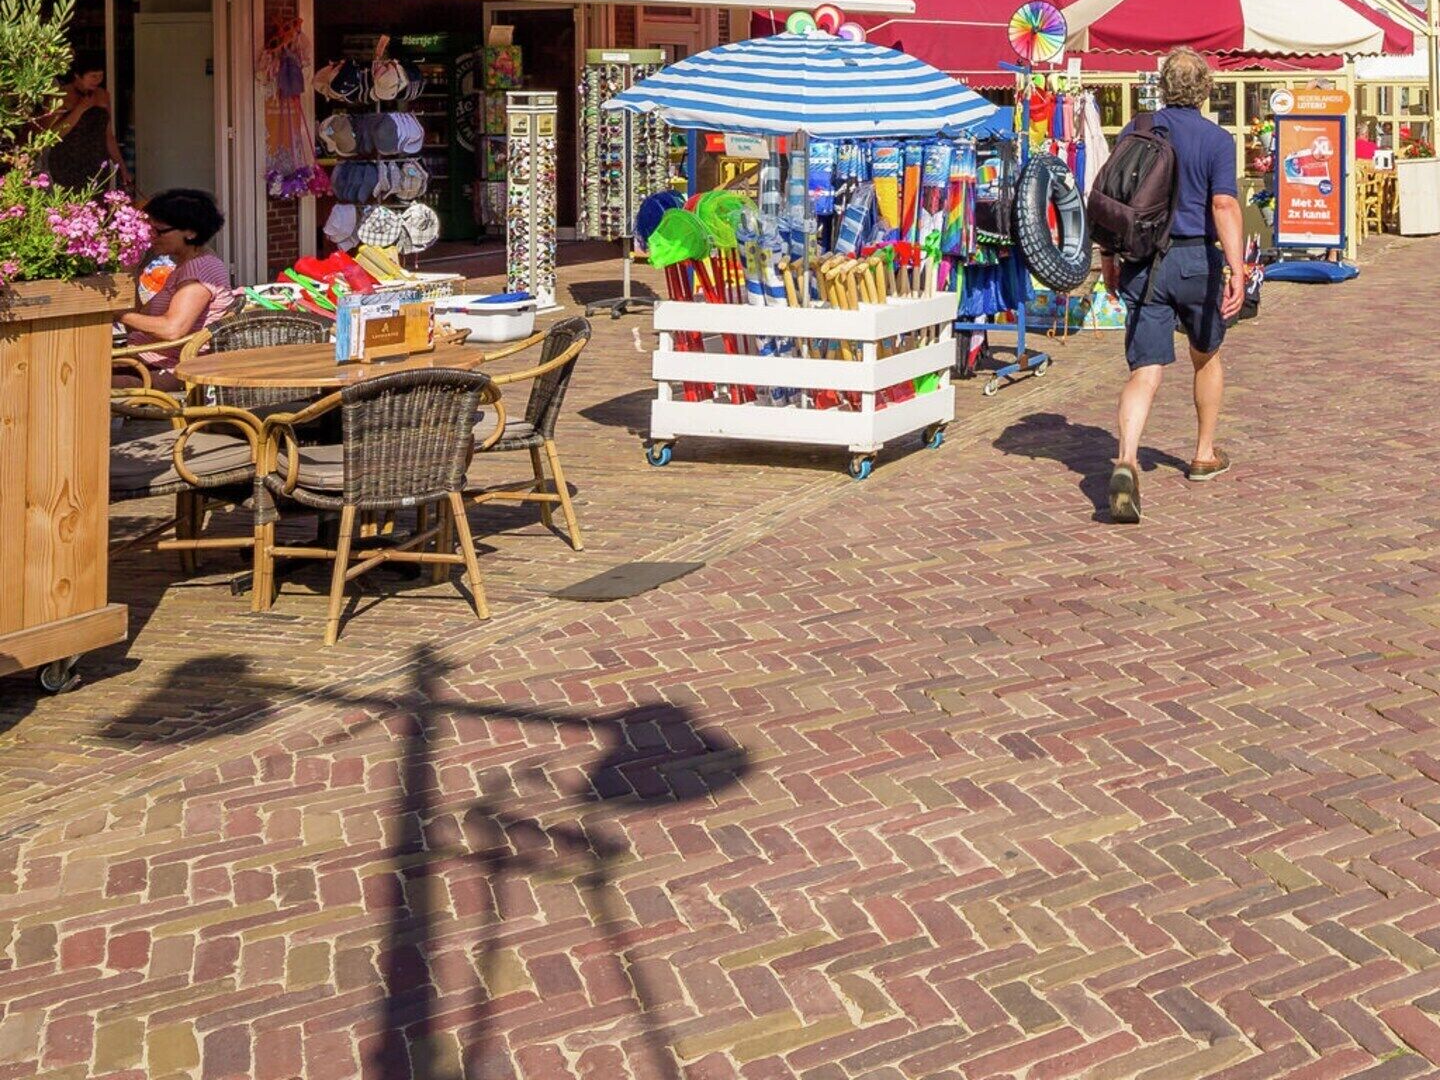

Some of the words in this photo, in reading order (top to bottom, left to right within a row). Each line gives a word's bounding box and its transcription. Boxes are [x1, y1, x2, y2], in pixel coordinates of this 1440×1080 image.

[1291, 198, 1312, 208] Met
[1287, 209, 1300, 219] 2x
[1302, 208, 1331, 220] kans!
